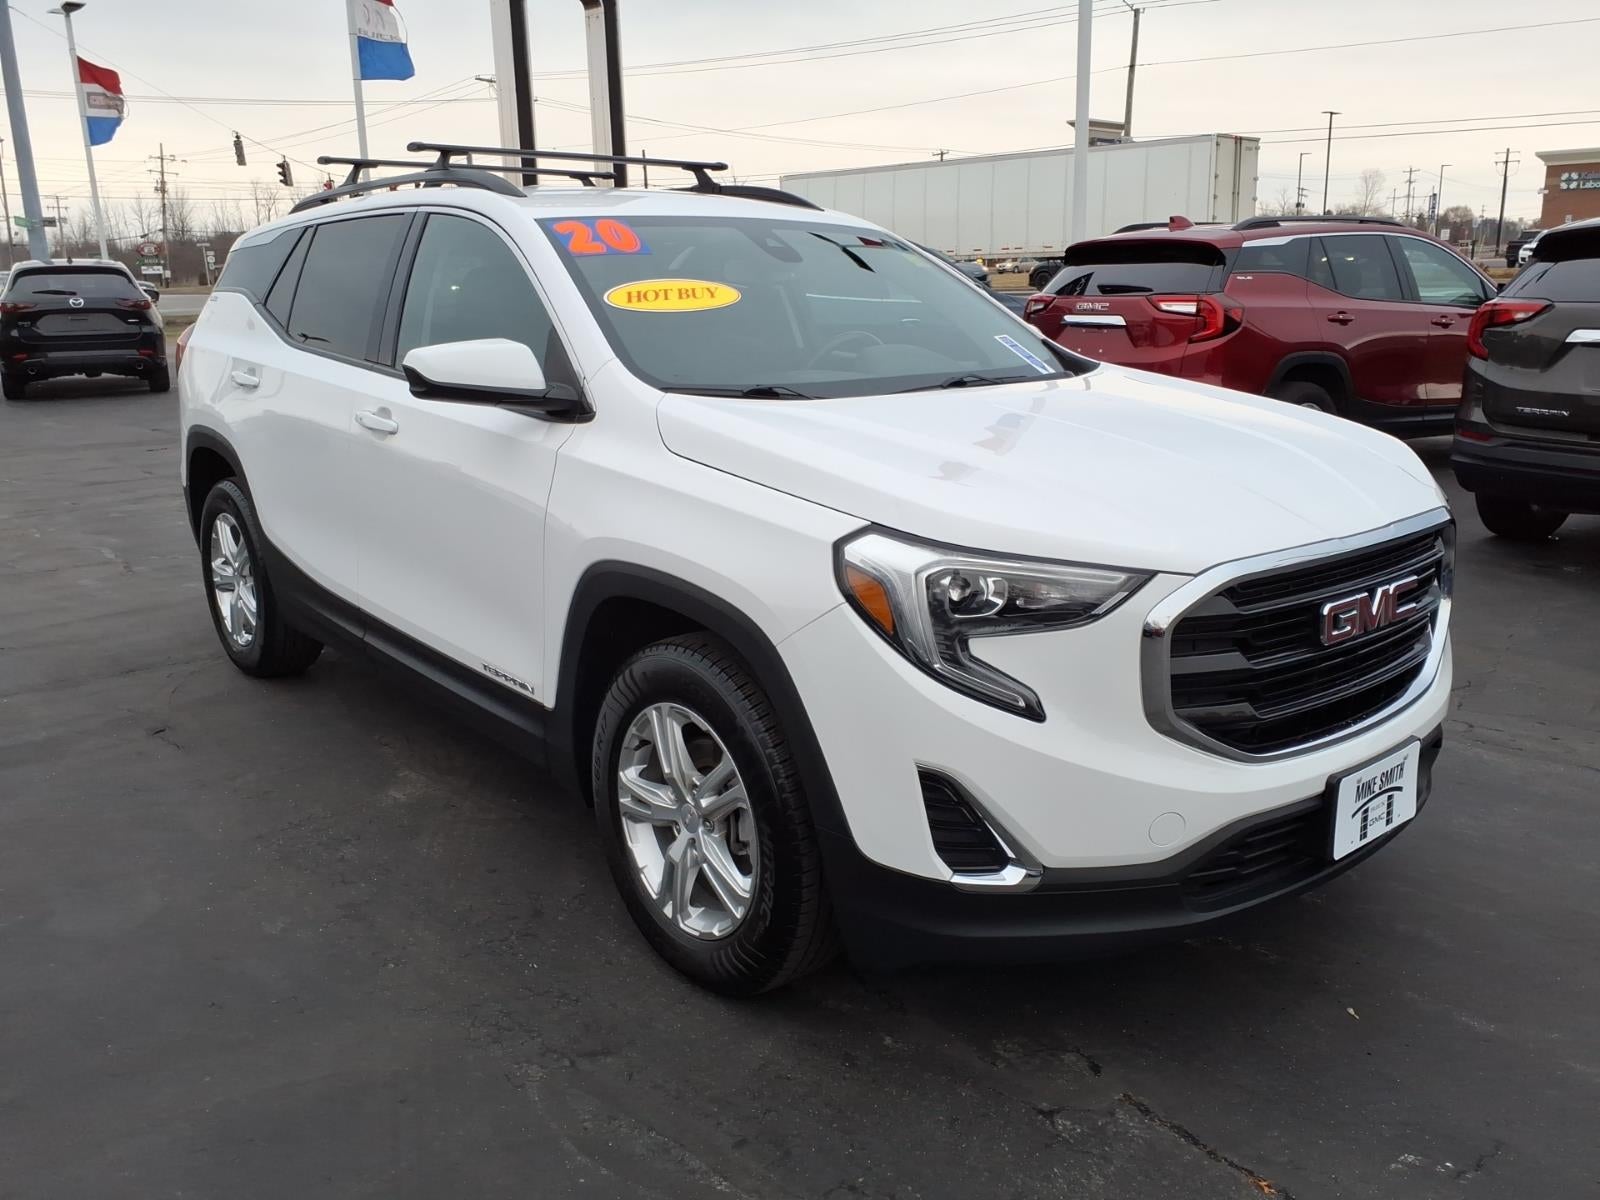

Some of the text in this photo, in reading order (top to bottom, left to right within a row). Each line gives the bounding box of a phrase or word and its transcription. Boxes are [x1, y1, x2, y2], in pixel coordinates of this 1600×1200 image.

[553, 219, 641, 254] 20
[626, 287, 718, 303] HOT BUY
[1076, 302, 1109, 310] GMC
[1321, 576, 1418, 646] GMC
[1355, 760, 1405, 804] MIKE SMITH
